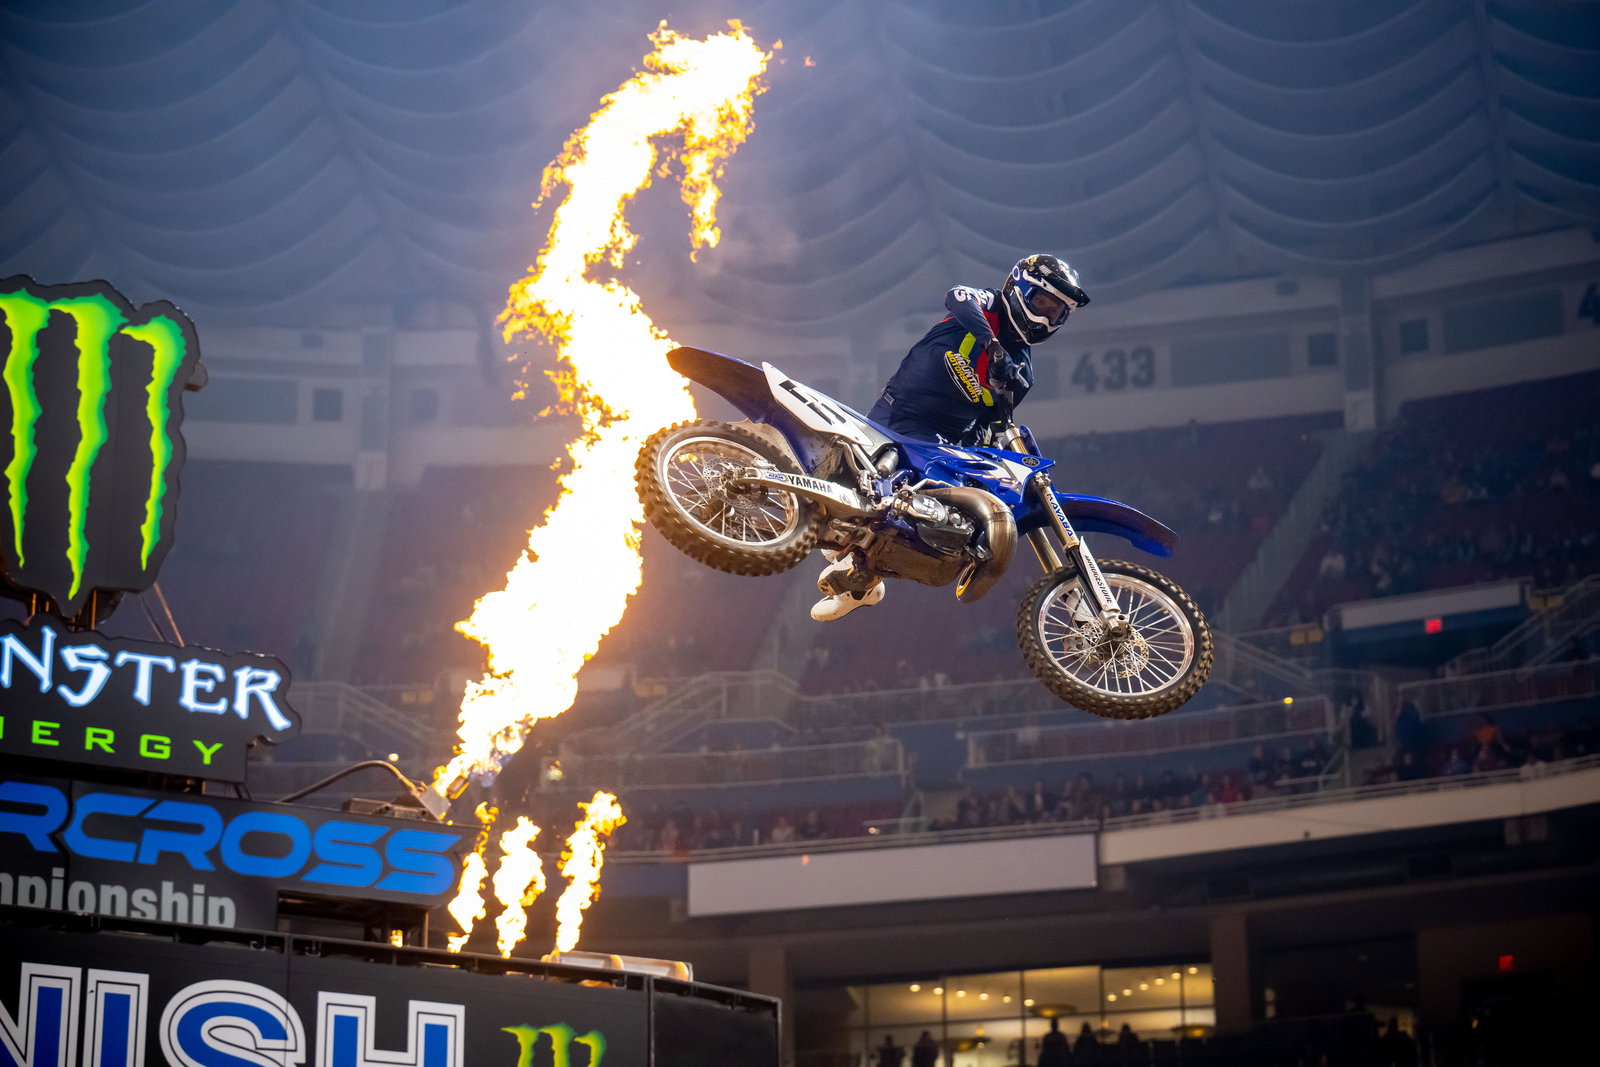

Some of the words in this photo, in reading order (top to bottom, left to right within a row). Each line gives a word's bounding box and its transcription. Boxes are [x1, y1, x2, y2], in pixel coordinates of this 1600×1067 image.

[945, 351, 979, 402] MOTORSPORTS
[954, 353, 983, 395] MOUNTAIN
[1071, 347, 1156, 394] 433
[787, 474, 834, 494] YAMAHA
[1046, 493, 1074, 537] KAYABA
[0, 626, 292, 731] NSTER
[0, 716, 223, 764] ERGY
[0, 781, 462, 896] RCROSS
